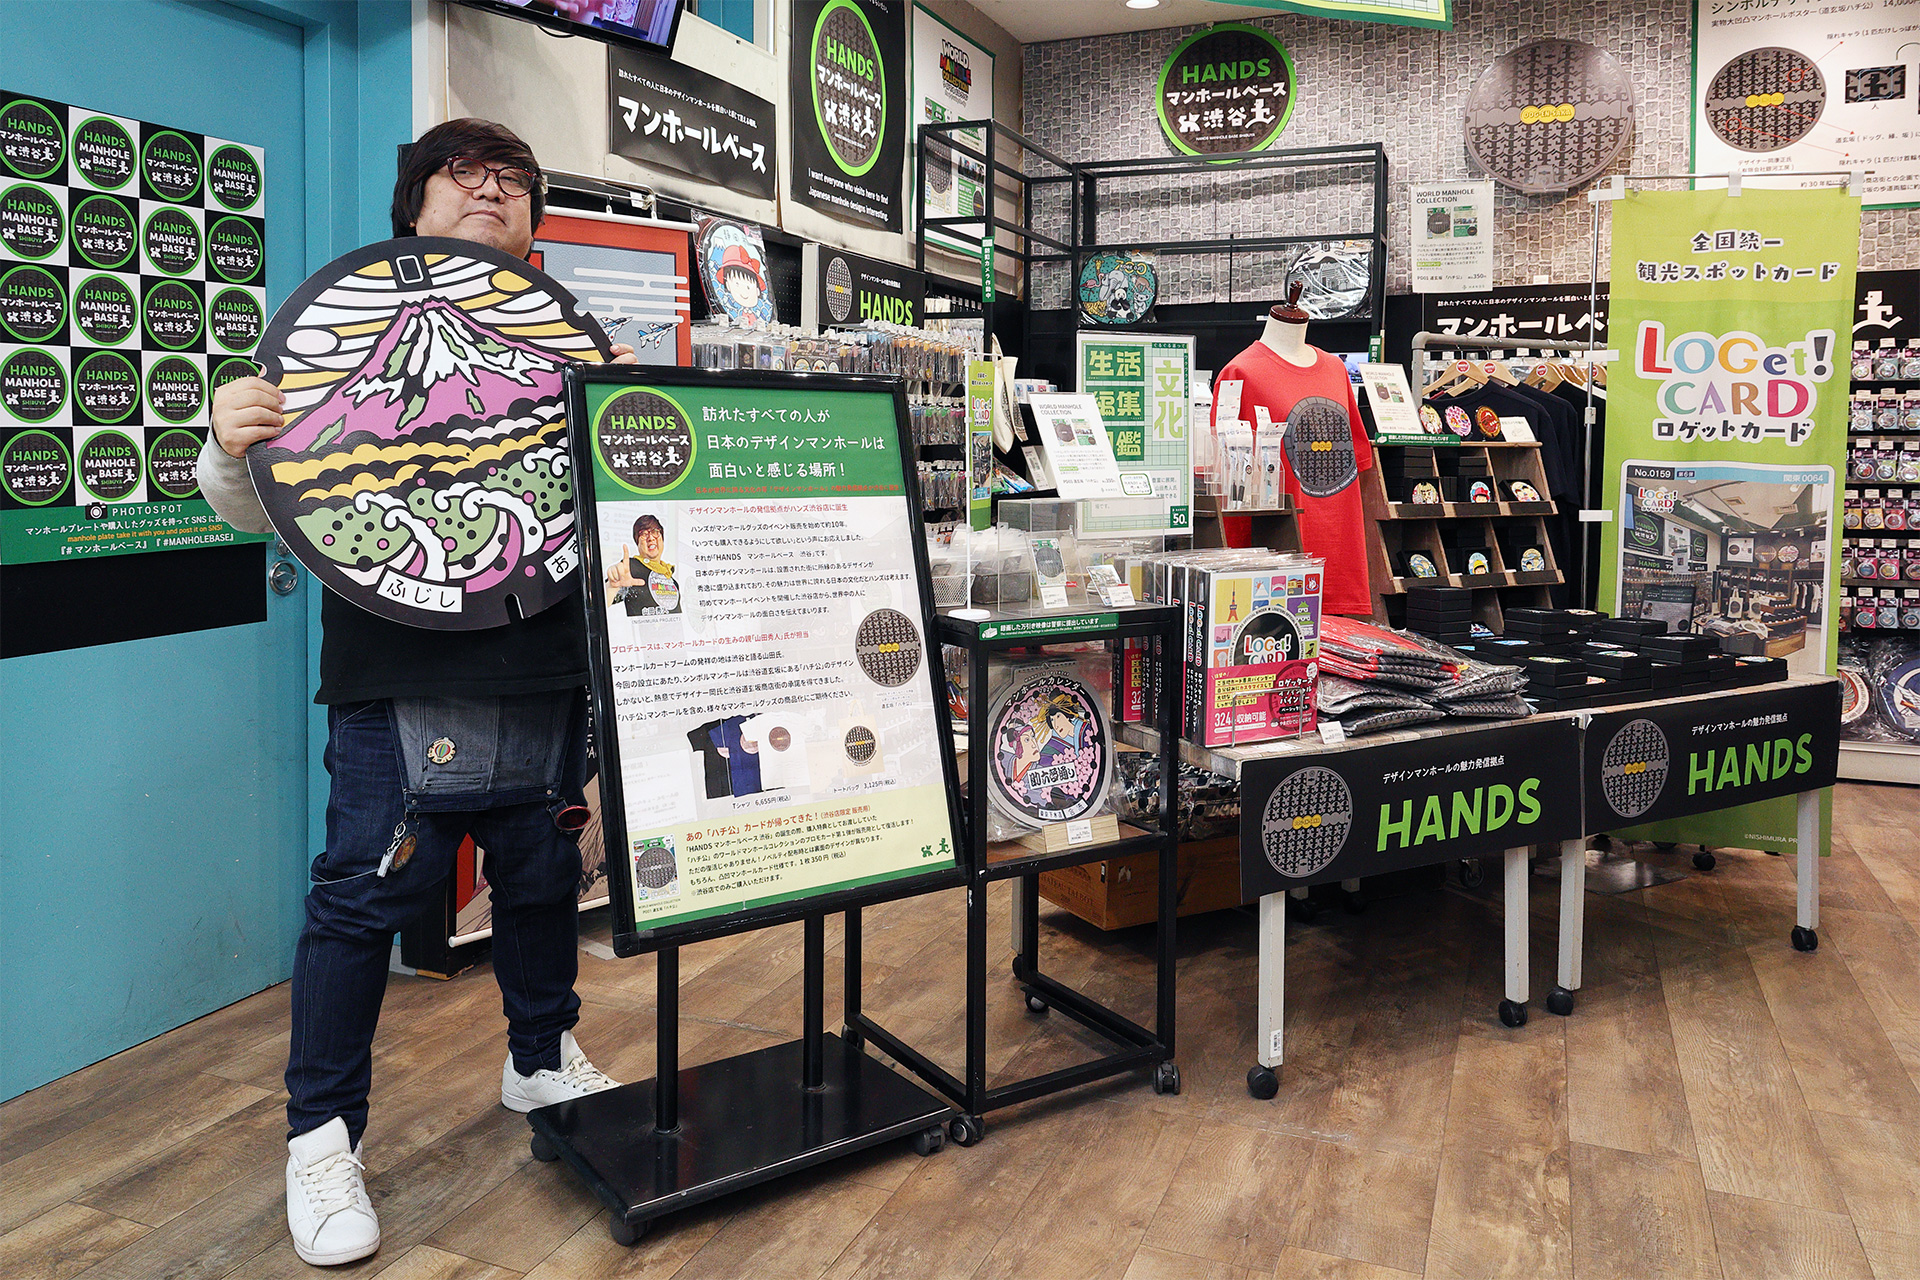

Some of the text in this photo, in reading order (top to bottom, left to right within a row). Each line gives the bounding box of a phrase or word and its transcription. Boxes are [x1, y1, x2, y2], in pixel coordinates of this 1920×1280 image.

[827, 35, 874, 82] HANDS
[942, 39, 970, 70] WORLD
[1182, 58, 1272, 84] HANDS
[817, 64, 882, 111] マンホールベース
[1166, 82, 1288, 106] マンホールベース
[838, 102, 863, 133] 渋谷
[1204, 106, 1248, 130] 渋谷
[8, 117, 54, 137] HANDS
[0, 130, 61, 150] マンホールベース
[84, 130, 126, 148] HANDS
[618, 95, 767, 175] マンホールベース
[18, 146, 41, 160] 渋谷
[79, 142, 131, 161] MANHOLE
[153, 146, 192, 164] HANDS
[92, 155, 117, 168] BASE
[146, 158, 199, 175] マンホールベース
[217, 158, 253, 173] HANDS
[163, 172, 182, 186] 渋谷
[213, 168, 256, 184] MANHOLE
[224, 180, 246, 191] BASE
[811, 170, 876, 200] want everyone who here
[808, 186, 831, 202] Japanese
[831, 195, 850, 208] manhole
[1416, 188, 1475, 198] WORLD MANHOLE
[1416, 196, 1458, 204] COLLECTION
[7, 198, 53, 216] HANDS
[2, 210, 58, 228] MANHOLE
[84, 212, 126, 228] HANDS
[16, 224, 44, 236] BASE
[76, 224, 133, 240] マンホールベース
[154, 220, 193, 236] HANDS
[94, 238, 116, 252] 渋谷
[149, 232, 197, 247] MANHOLE
[217, 232, 253, 246] HANDS
[1693, 232, 1782, 252] 全国統一
[162, 243, 185, 255] BASE
[211, 243, 260, 257] マンホールベース
[226, 255, 245, 266] 渋谷
[1638, 262, 1838, 283] 観光スポットカード
[8, 284, 55, 299] HANDS
[84, 289, 127, 303] HANDS
[0, 298, 63, 311] マンホールベース
[80, 301, 131, 314] MANHOLE
[154, 298, 194, 311] HANDS
[218, 301, 255, 313] HANDS
[860, 290, 913, 326] HANDS
[20, 310, 43, 324] 渋谷
[94, 312, 119, 324] BASE
[147, 308, 200, 322] マンホールベース
[214, 312, 258, 324] MANHOLE
[164, 321, 184, 333] 渋谷
[226, 322, 248, 332] BASE
[1437, 312, 1610, 338] マンホールベ
[1643, 328, 1828, 376] LOGet!
[10, 364, 57, 377] HANDS
[1089, 350, 1142, 377] 生活
[4, 377, 61, 389] MANHOLE
[86, 370, 129, 382] HANDS
[156, 370, 196, 382] HANDS
[20, 388, 47, 400] BASE
[78, 382, 136, 393] マンホールベース
[152, 382, 200, 393] MANHOLE
[96, 394, 118, 406] 渋谷
[164, 391, 188, 402] BASE
[1154, 360, 1184, 439] 文化
[1664, 380, 1810, 418] CARD
[702, 406, 831, 424] 訪れたすべての人が
[974, 410, 990, 421] CARD
[611, 415, 677, 430] HANDS
[1658, 421, 1810, 442] ロゲットカード
[600, 434, 690, 447] マンホールベース
[707, 434, 886, 451] 日本のデザインマンホールは
[12, 450, 59, 462] HANDS
[89, 446, 132, 459] HANDS
[158, 447, 198, 458] HANDS
[631, 450, 664, 467] 渋谷
[4, 462, 68, 473] マンホールベース
[84, 458, 136, 469] MANHOLE
[708, 462, 846, 479] 面白いと感じる場所！
[98, 468, 124, 478] BASE
[169, 470, 189, 481] 渋谷
[1634, 469, 1671, 479] No.0159
[1784, 474, 1824, 483] 関東 0064
[24, 474, 48, 487] 渋谷
[112, 504, 183, 518] PHOTOSPOT
[1644, 500, 1674, 509] CARD
[192, 514, 207, 524] SNS
[67, 534, 96, 543] manhole
[97, 533, 115, 542] plate
[138, 530, 153, 538] with
[153, 530, 166, 538] you
[166, 528, 178, 536] and
[178, 527, 193, 536] post
[208, 524, 223, 532] SNS!
[387, 578, 456, 609] ふじし
[1246, 634, 1291, 654] LOGet!
[1250, 652, 1286, 665] CARD
[1214, 712, 1267, 727] 324収納可能
[1692, 712, 1788, 736] デザインマンホールの魅力発信拠点
[1382, 754, 1505, 785] デザインマンホールの魅力発信拠点
[1688, 732, 1813, 796] HANDS
[1377, 777, 1542, 852] HANDS
